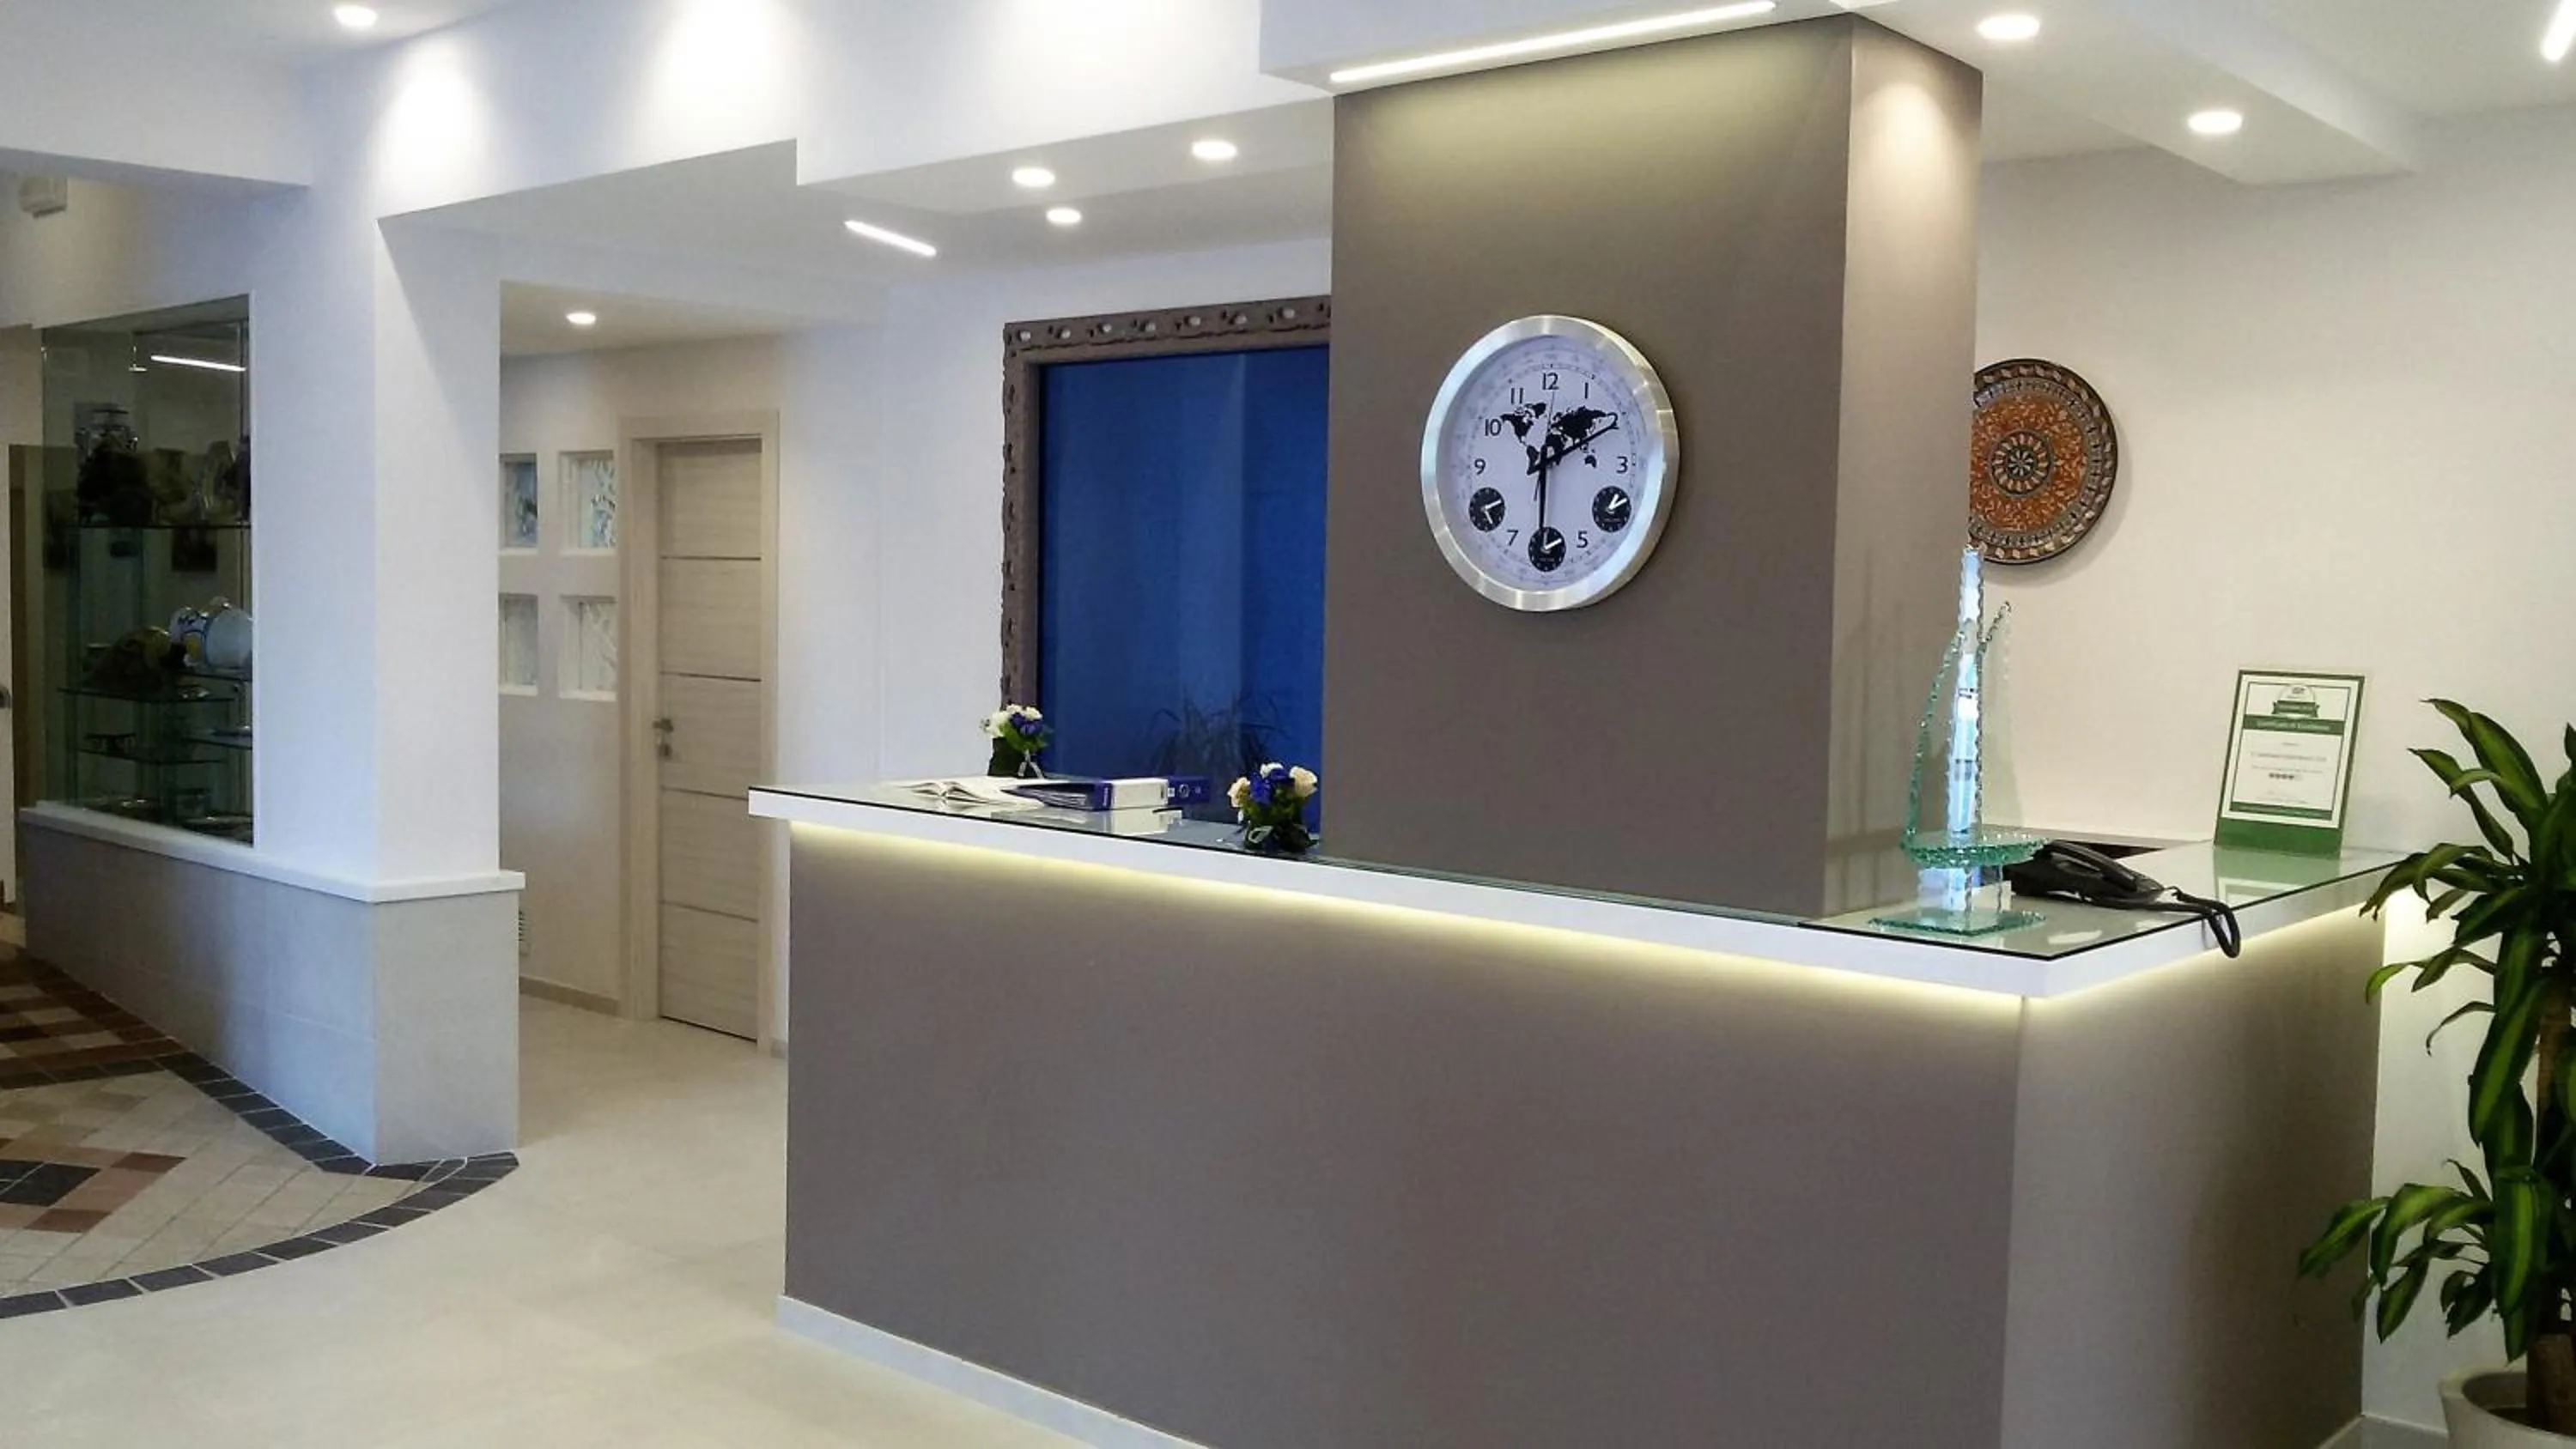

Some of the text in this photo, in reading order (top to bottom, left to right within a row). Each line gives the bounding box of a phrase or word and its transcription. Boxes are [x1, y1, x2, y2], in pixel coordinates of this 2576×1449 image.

[1542, 373, 1560, 391] 12
[1584, 382, 1589, 400] 1
[1510, 387, 1524, 406] 11
[1485, 417, 1503, 437] 10
[1610, 413, 1620, 430] 2
[1473, 457, 1486, 476] 9
[1616, 455, 1629, 475] 3
[1506, 529, 1519, 547] 7
[1576, 530, 1589, 549] 5
